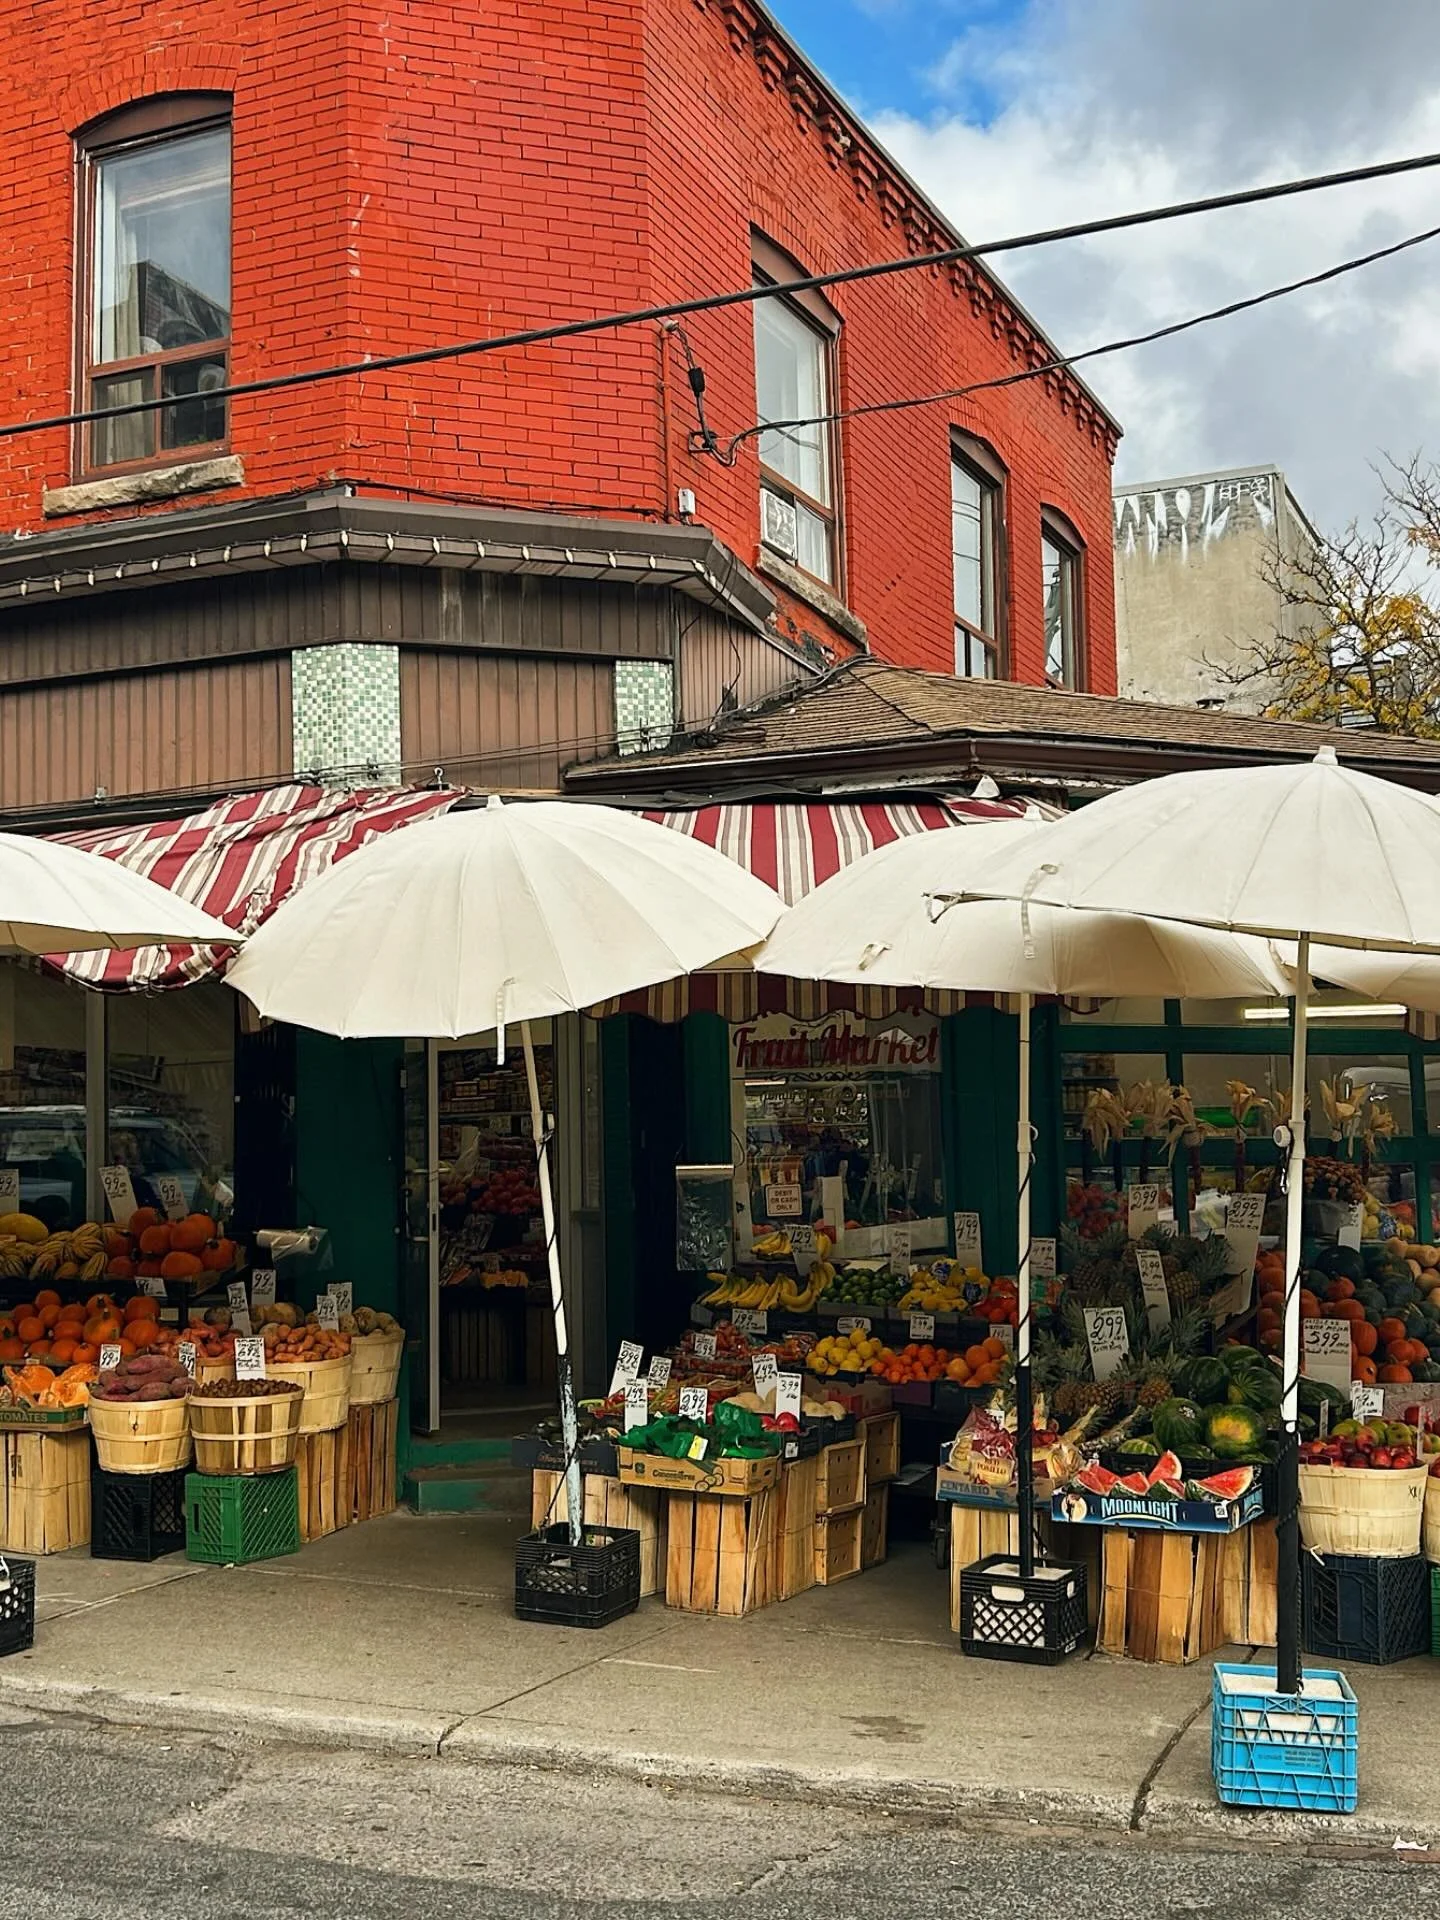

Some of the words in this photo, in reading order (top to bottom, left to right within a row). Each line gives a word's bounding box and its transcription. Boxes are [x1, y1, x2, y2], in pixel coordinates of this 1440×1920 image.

[733, 1027, 810, 1068] Fruit
[820, 1025, 939, 1065] Market
[253, 1273, 271, 1288] 99
[1090, 1316, 1123, 1341] 299
[1305, 1330, 1340, 1347] 599
[1101, 1497, 1179, 1523] MOONLIGHT
